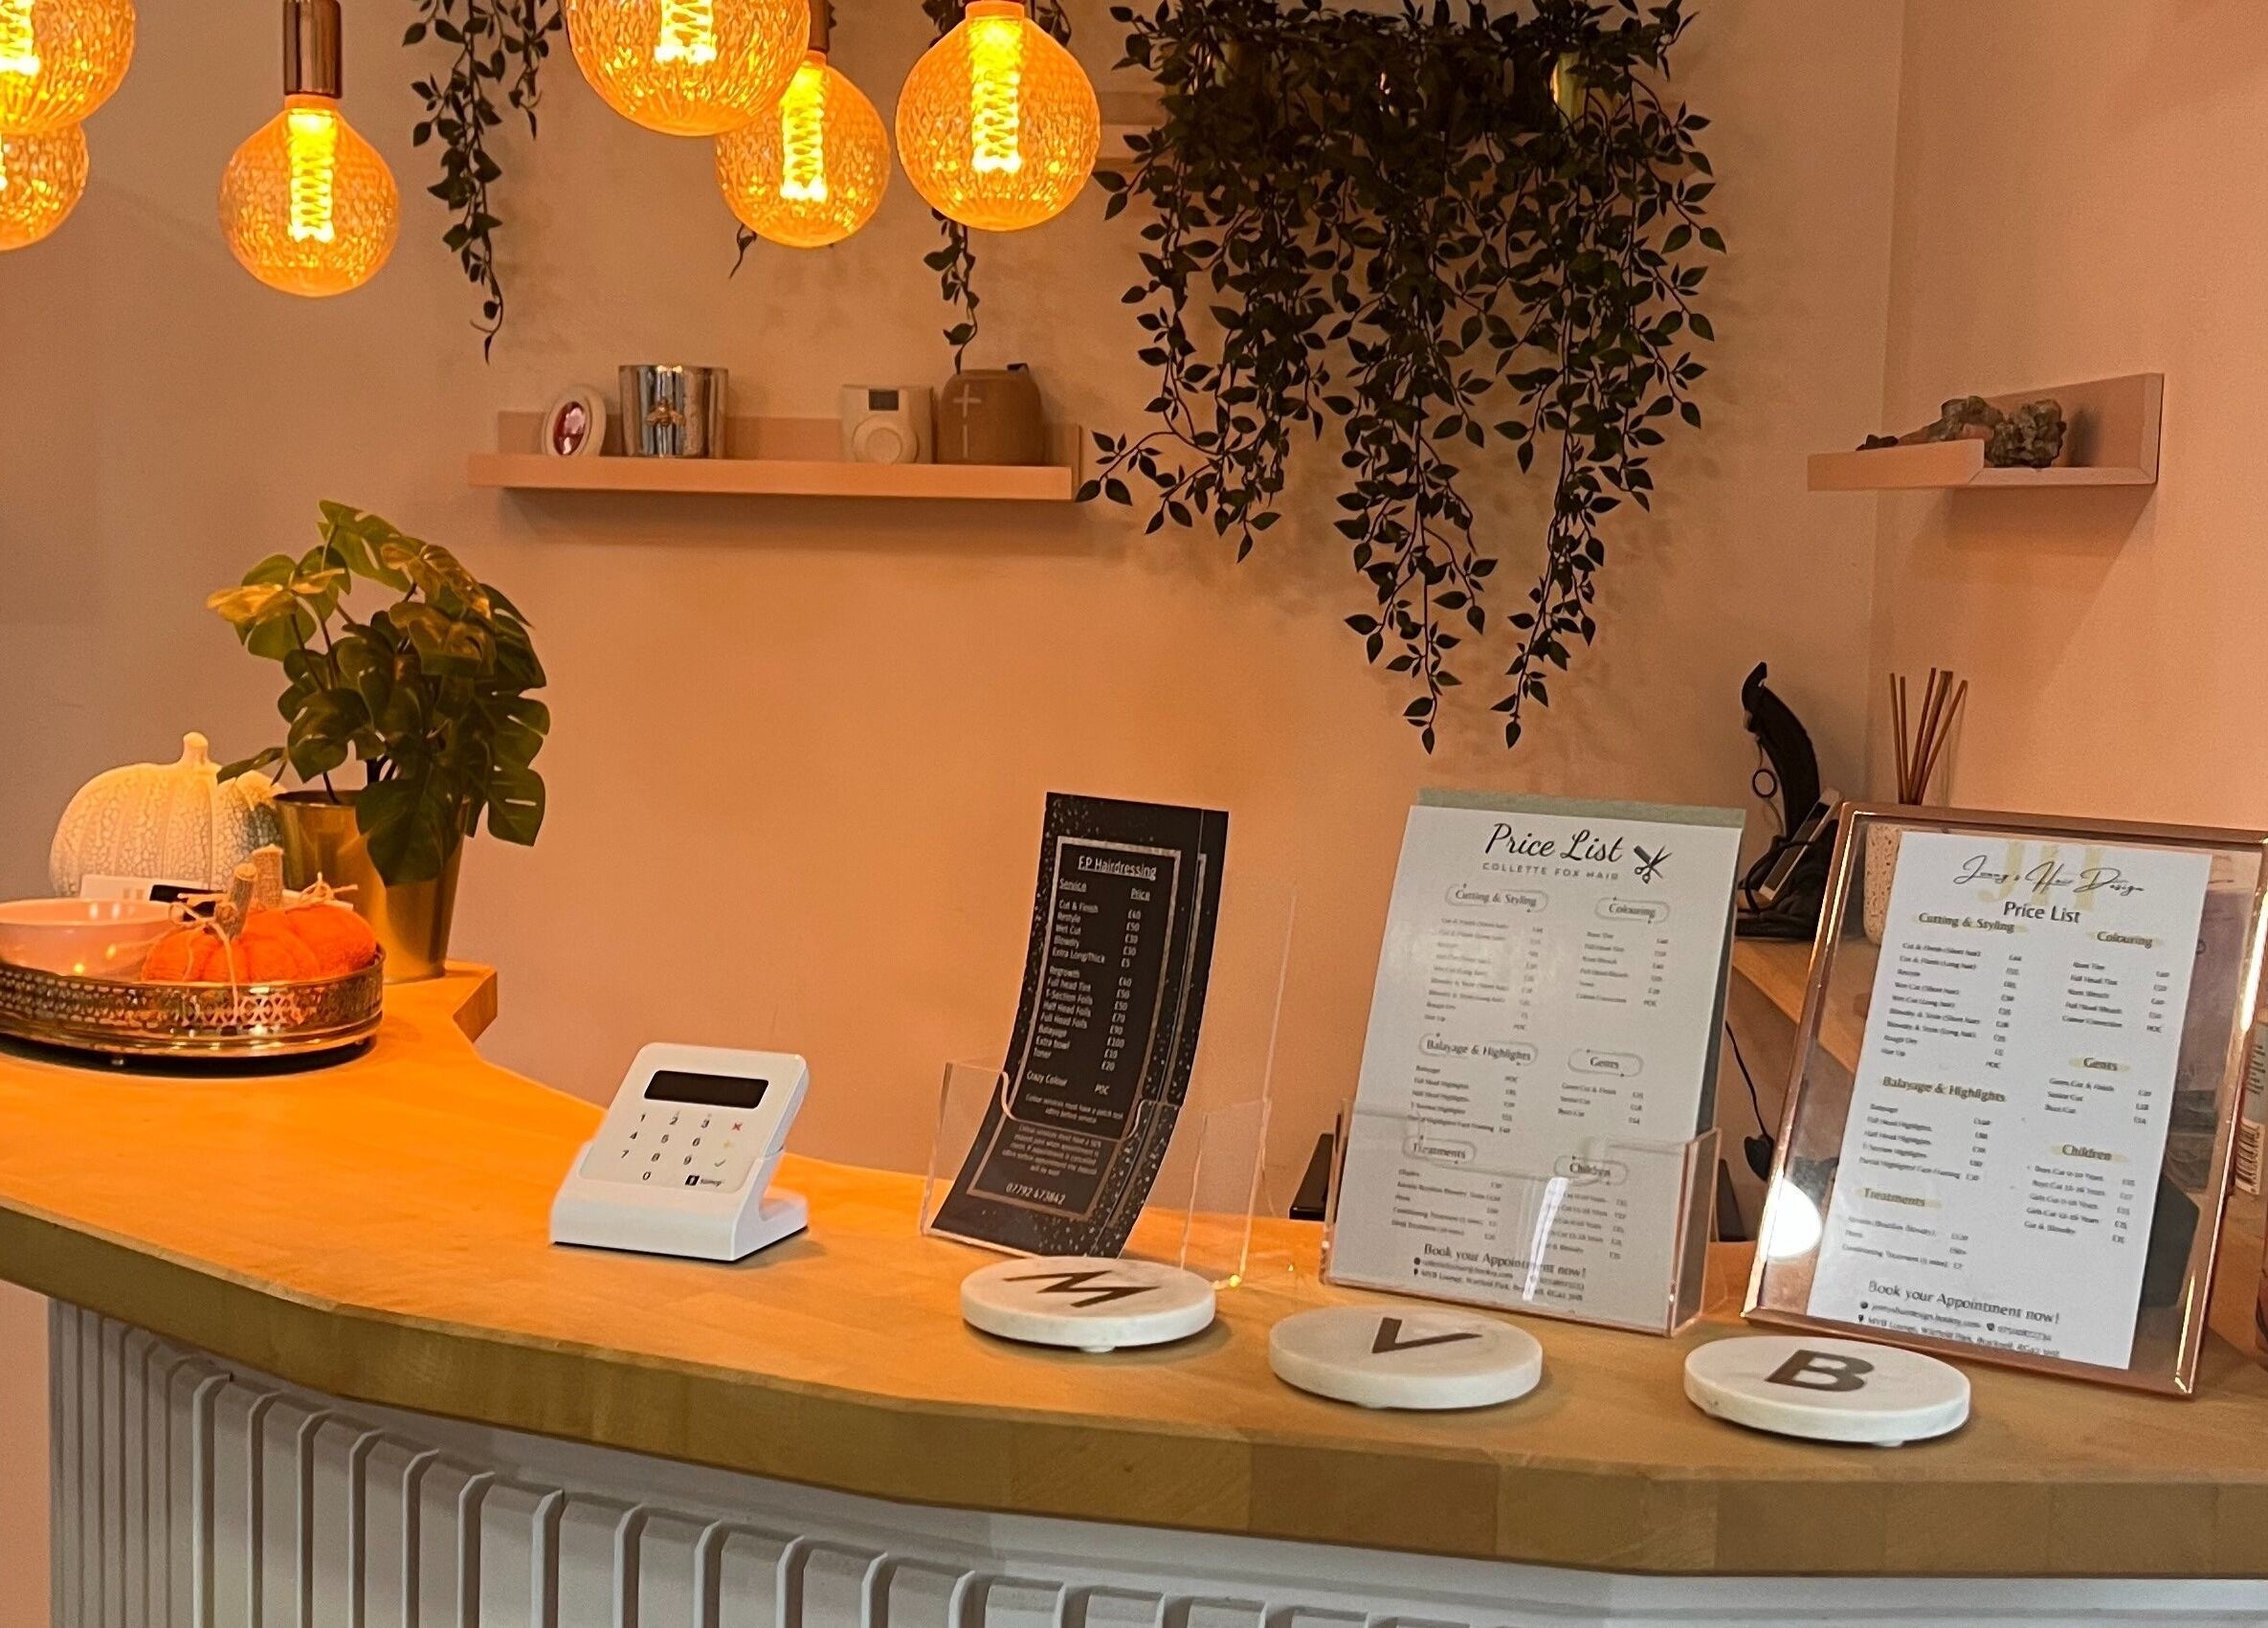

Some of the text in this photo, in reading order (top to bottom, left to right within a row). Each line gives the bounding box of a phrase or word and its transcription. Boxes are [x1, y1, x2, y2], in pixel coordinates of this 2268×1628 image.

[1485, 822, 1624, 862] Price List
[1094, 858, 1157, 881] Hairdressing
[1482, 861, 1547, 876] COLLETTE
[1554, 868, 1579, 878] FOX
[1059, 878, 1087, 892] Service
[1130, 887, 1151, 902] Price
[1504, 894, 1537, 908] Styling
[2003, 901, 2080, 925] Price List
[1918, 912, 2015, 934] Cutting & Styling
[2097, 930, 2153, 948] Colouring
[1481, 1046, 1531, 1061] Highlights
[1882, 1076, 2008, 1103] Balayage & Highlights
[668, 1116, 678, 1126] 2
[700, 1119, 709, 1128] 3
[629, 1131, 700, 1147] 4 5 6
[621, 1149, 691, 1165] 7 8 9
[2061, 1144, 2113, 1161] Children
[642, 1171, 651, 1180] 0
[1863, 1187, 1925, 1207] Treatments
[1424, 1243, 1452, 1258] Book
[1456, 1251, 1479, 1260] your
[1868, 1280, 1901, 1297] Book
[1904, 1289, 1934, 1302] your
[1935, 1293, 2023, 1320] Appointment
[2025, 1309, 2060, 1326] now!
[1371, 1317, 1483, 1354] V
[1765, 1349, 1875, 1393] B
